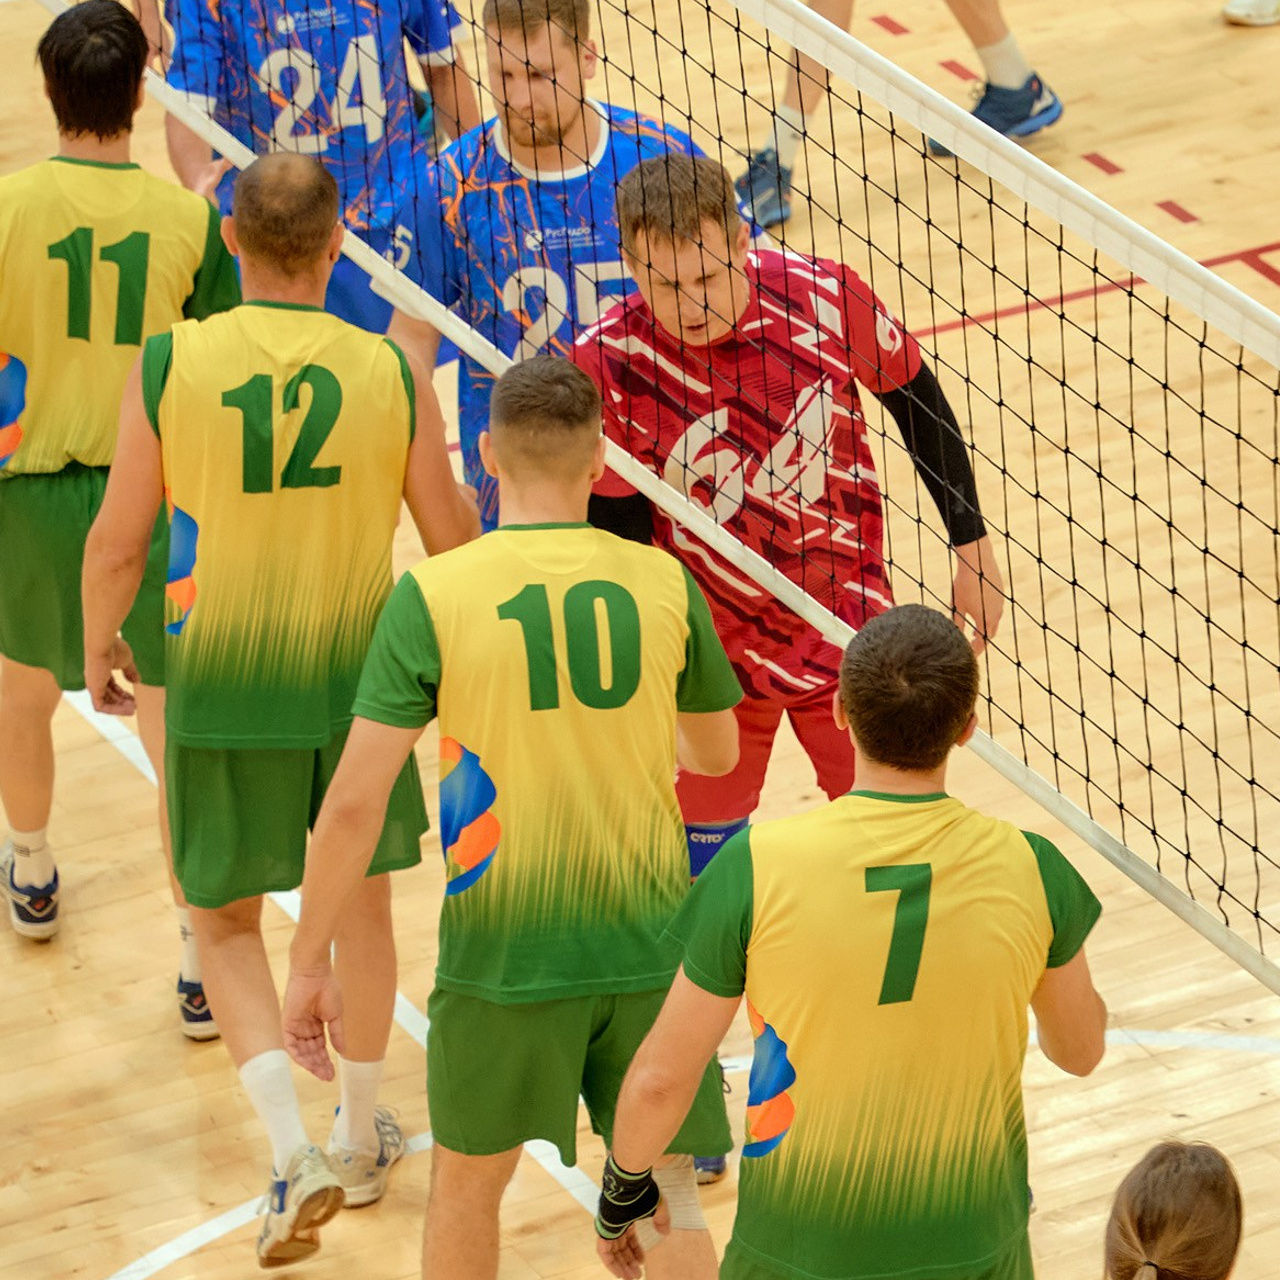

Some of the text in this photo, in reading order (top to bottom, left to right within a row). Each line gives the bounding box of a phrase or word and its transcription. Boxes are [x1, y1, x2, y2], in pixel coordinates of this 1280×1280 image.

[258, 35, 388, 155] 24
[48, 227, 150, 345] 11
[221, 364, 343, 494] 12
[664, 374, 834, 525] 64
[496, 580, 641, 710] 10
[865, 863, 932, 1005] 7
